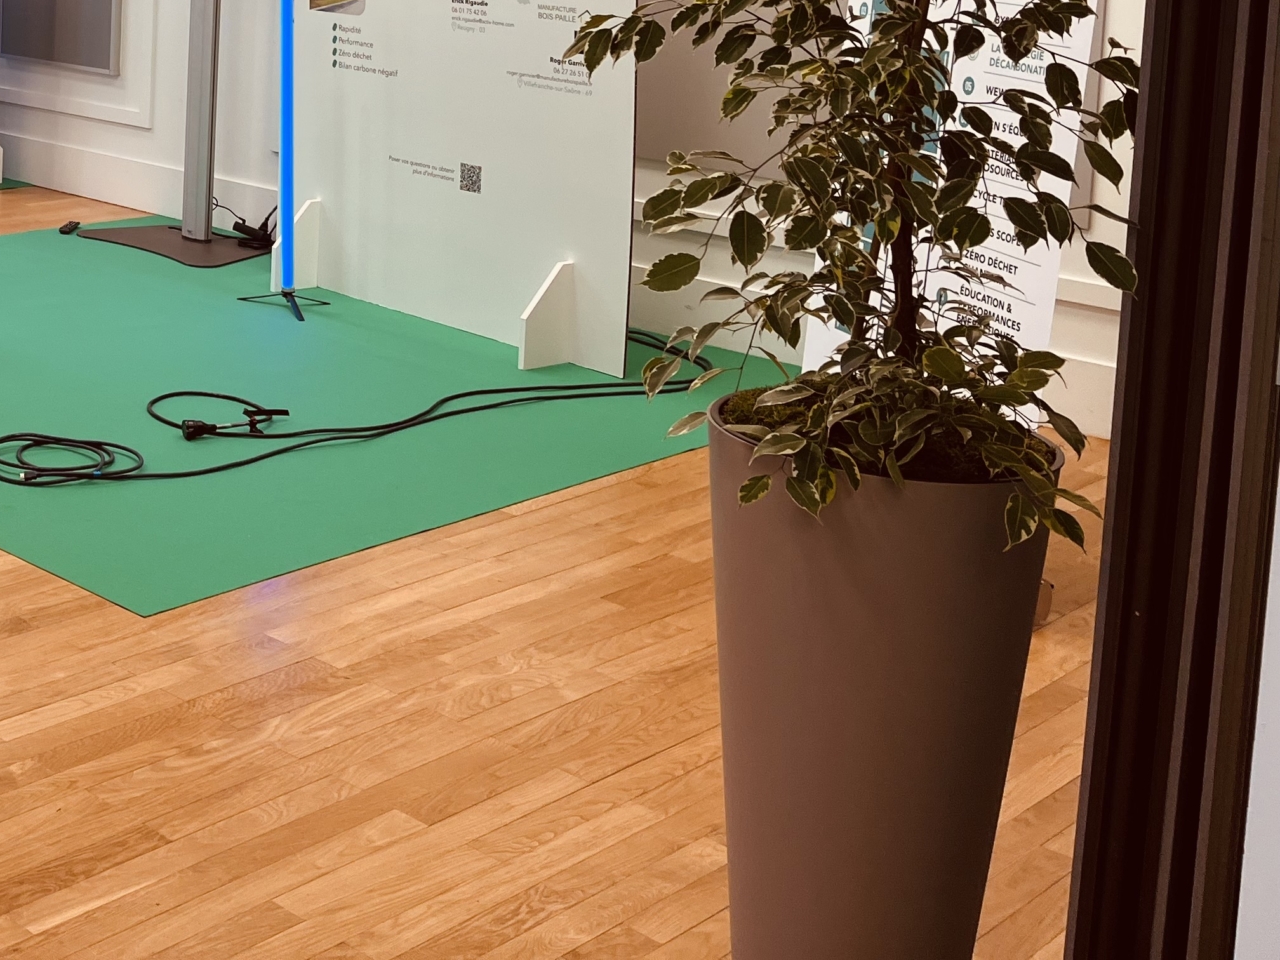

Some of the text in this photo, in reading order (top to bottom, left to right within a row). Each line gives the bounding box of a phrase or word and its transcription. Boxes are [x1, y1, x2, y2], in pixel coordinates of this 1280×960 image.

[538, 4, 576, 13] MANUFACTURE
[538, 12, 576, 23] BOIS PAILLE
[339, 24, 361, 34] Rapidité
[339, 37, 373, 48] Performance
[338, 49, 372, 60] Zéro déchet
[339, 61, 398, 78] Bilan carbone négatif
[965, 249, 985, 263] ZÉRO
[987, 257, 1018, 275] DÉCHET
[960, 284, 1005, 310] ÉDUCATION
[1006, 303, 1012, 314] &
